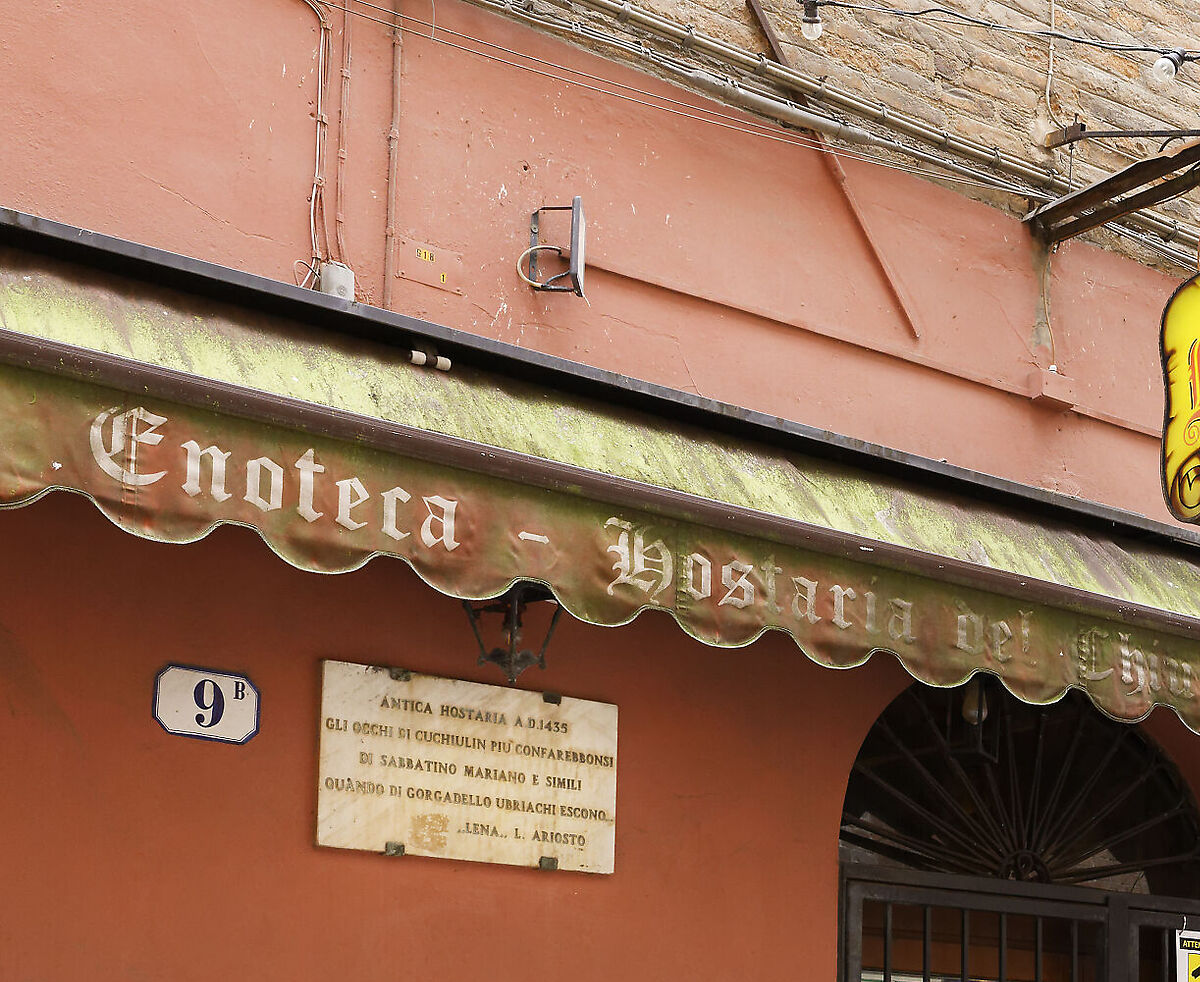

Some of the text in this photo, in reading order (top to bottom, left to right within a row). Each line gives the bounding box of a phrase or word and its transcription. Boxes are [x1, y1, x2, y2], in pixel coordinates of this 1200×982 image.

[90, 406, 461, 551] Enoteca
[603, 516, 917, 644] Hostaria
[380, 695, 433, 714] ANTICA
[441, 704, 507, 725] HOSTARIA
[325, 717, 348, 732] GLI
[352, 720, 393, 738] OCCHI
[398, 727, 411, 740] DI
[415, 730, 486, 750] CUCHIULIN
[515, 744, 614, 768] CONFAREBBONSI
[359, 751, 582, 791] DI SABBATINO MARIANO E SIMILI
[324, 776, 385, 796] QUANDO
[389, 784, 402, 798] DI
[407, 787, 492, 808] GORGADELLO
[496, 797, 556, 816] UBRIACHI
[532, 829, 586, 847] ARIOSTO
